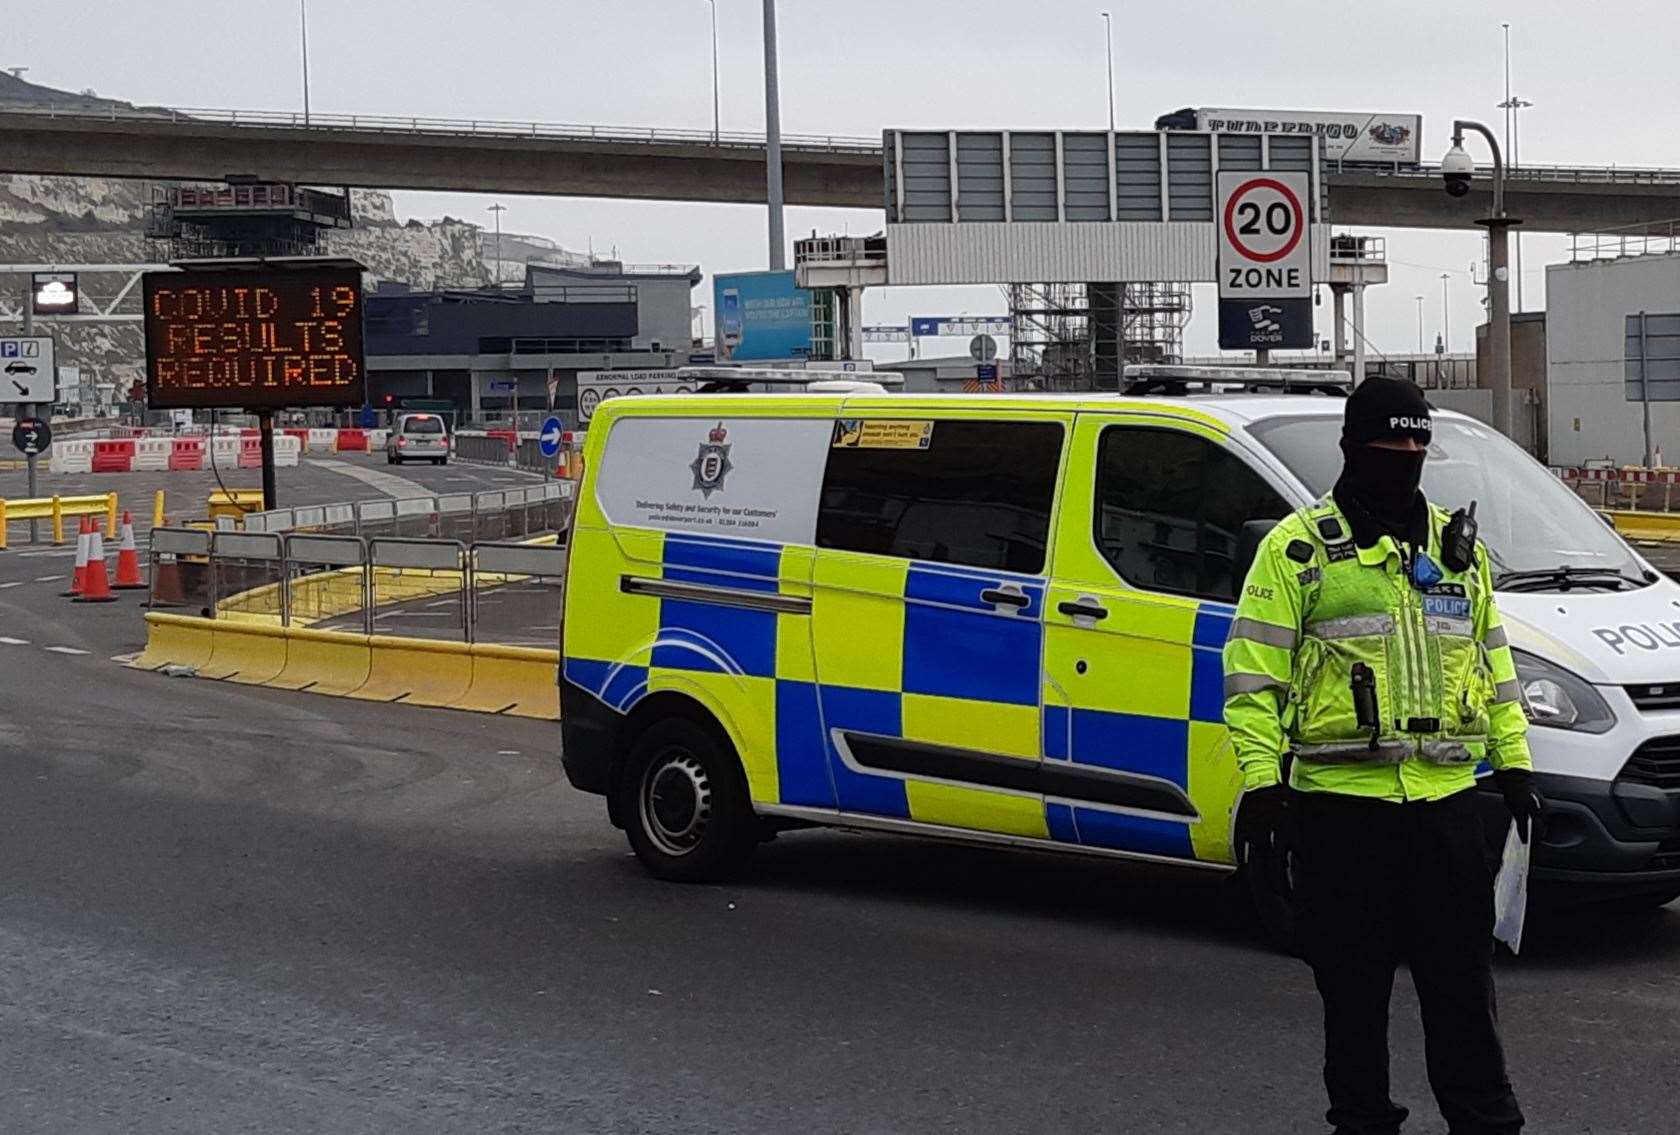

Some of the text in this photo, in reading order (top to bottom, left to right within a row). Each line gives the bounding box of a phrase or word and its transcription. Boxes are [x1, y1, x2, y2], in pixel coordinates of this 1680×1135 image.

[1238, 202, 1291, 235] 20
[1229, 268, 1300, 288] ZONE
[153, 286, 354, 319] COVID 19
[168, 321, 343, 354] RESULTS
[1250, 334, 1283, 343] DOVER
[156, 354, 357, 387] REQUIRED
[1389, 417, 1432, 431] POLICE
[665, 502, 683, 514] Safety
[684, 504, 696, 513] and
[697, 504, 722, 516] Security
[722, 506, 732, 515] for
[732, 508, 743, 516] our
[1246, 584, 1274, 601] OLICE
[1425, 598, 1469, 616] POLICE
[1591, 622, 1680, 655] POLI
